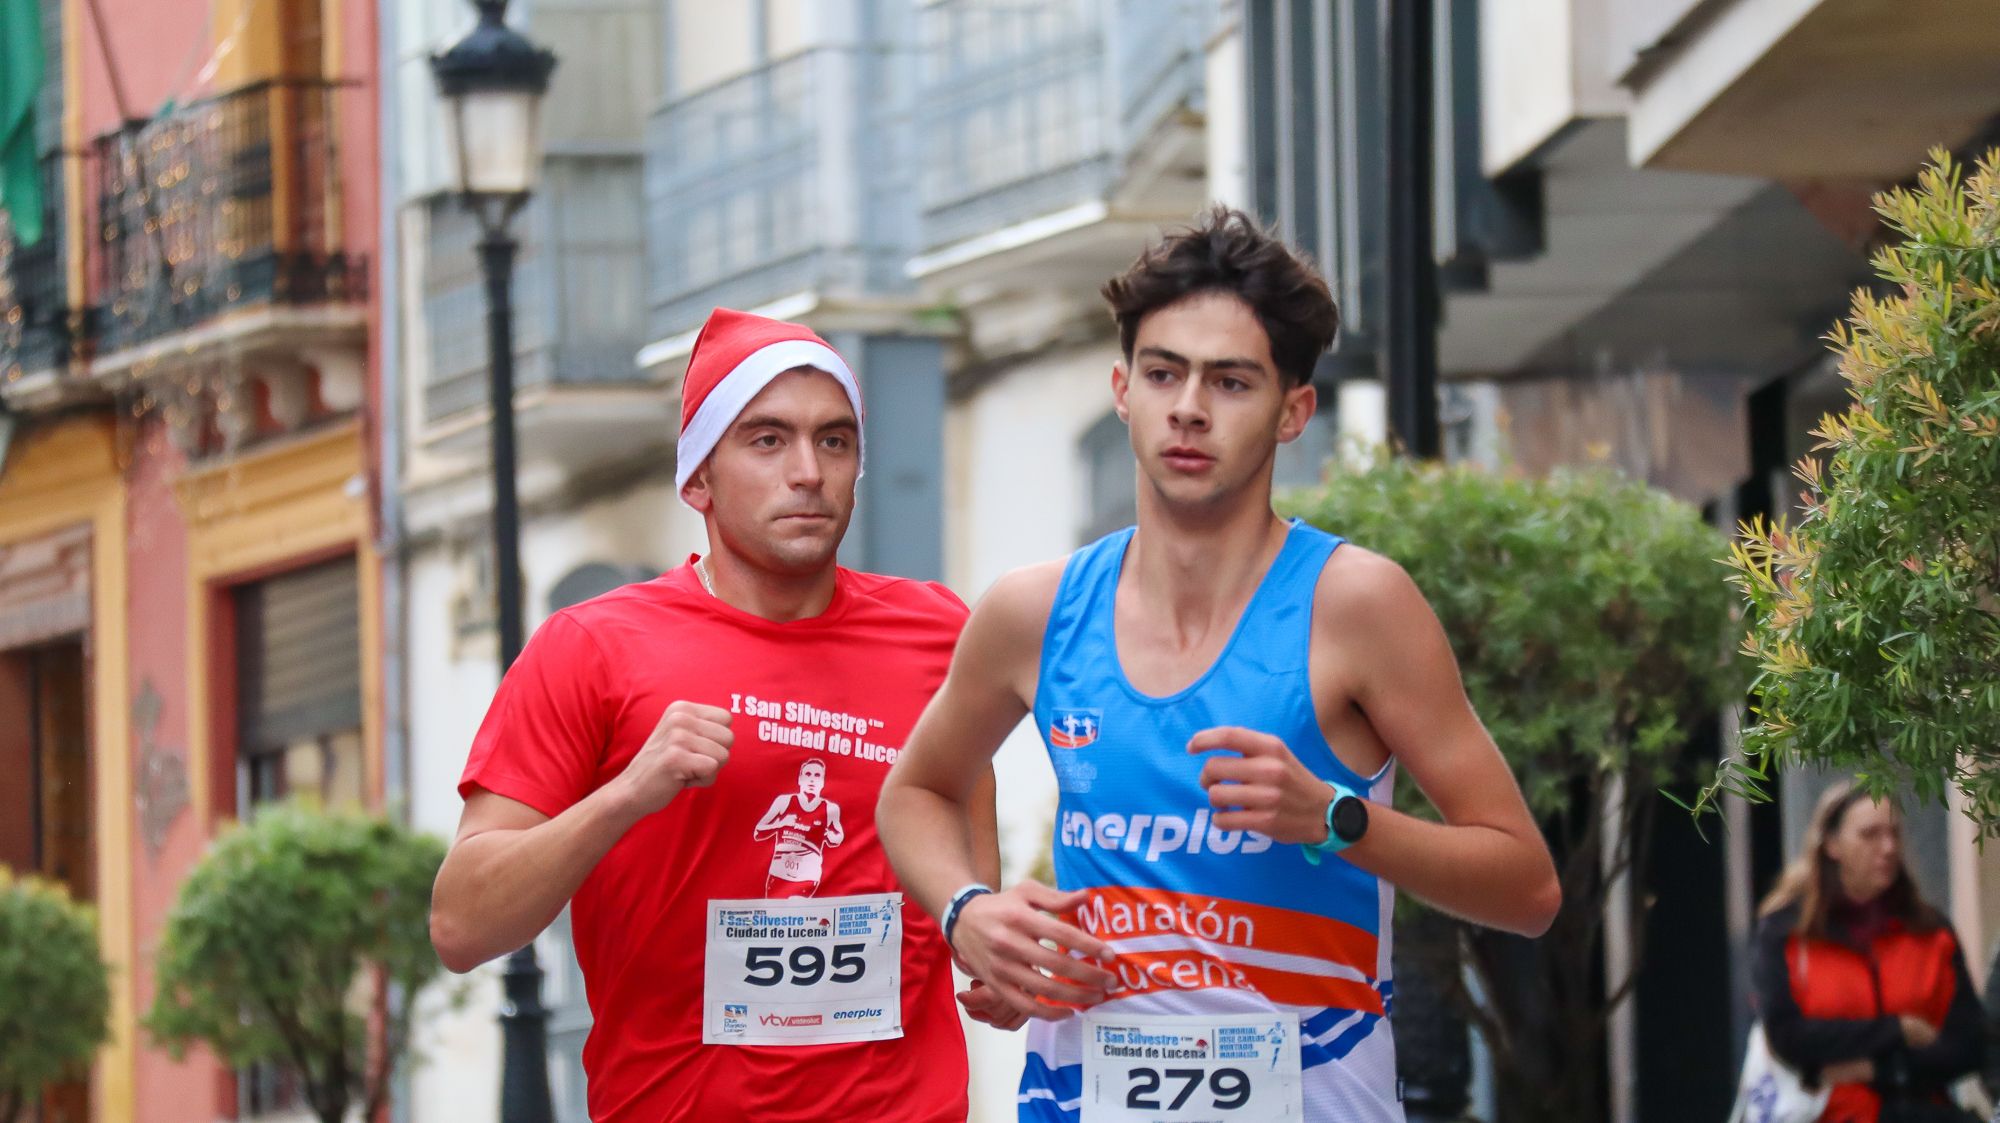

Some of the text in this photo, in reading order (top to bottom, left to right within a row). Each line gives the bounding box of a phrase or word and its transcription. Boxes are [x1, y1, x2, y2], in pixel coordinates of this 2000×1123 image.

[731, 694, 741, 713] I
[745, 696, 782, 720] San
[785, 701, 868, 735] Silvestre
[758, 720, 902, 765] Ciudad de Luce
[785, 860, 799, 871] 001
[727, 915, 750, 926] San
[752, 915, 804, 926] Silvestre
[1077, 894, 1254, 946] Maratón
[726, 927, 828, 938] Ciudad de Lucena
[744, 943, 866, 986] 595
[833, 1008, 882, 1019] enerplus
[1096, 1031, 1102, 1042] I
[1104, 1031, 1125, 1043] San
[1127, 1032, 1179, 1045] Silvestre
[1103, 1045, 1206, 1058] Ciudad de Lucena
[1126, 1067, 1251, 1110] 279
